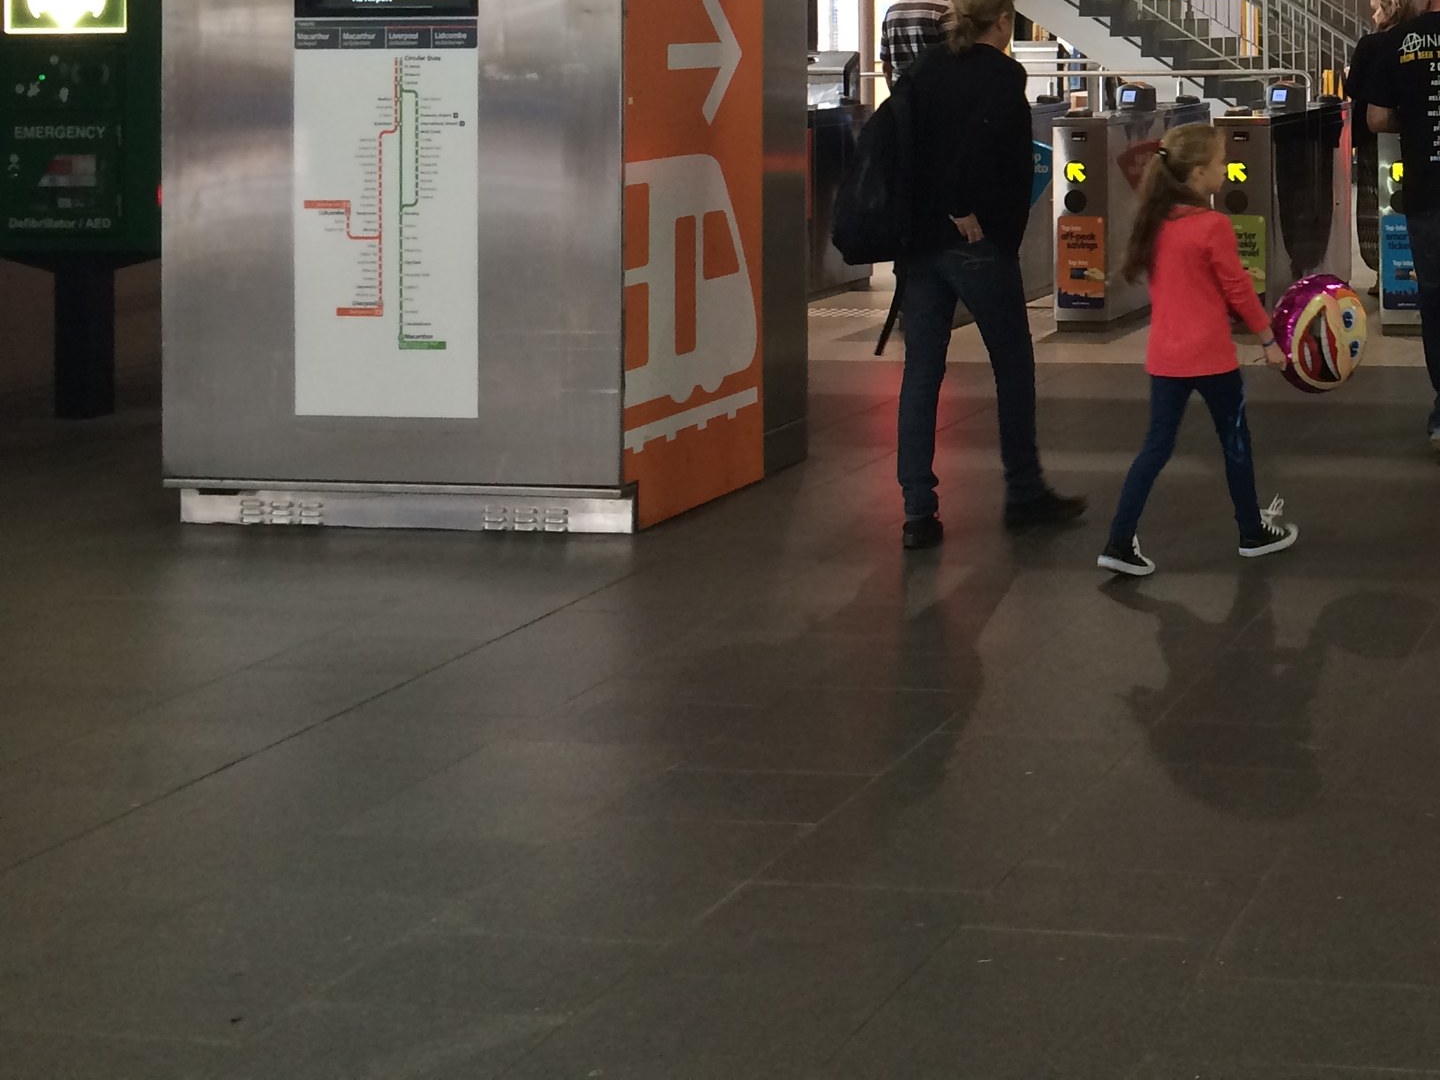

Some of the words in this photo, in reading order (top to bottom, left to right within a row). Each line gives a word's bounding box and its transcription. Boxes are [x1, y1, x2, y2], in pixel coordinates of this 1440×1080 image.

[14, 126, 105, 139] EMERGENCY
[86, 218, 111, 228] AED
[1061, 232, 1096, 242] off-peak
[1067, 242, 1098, 251] savings
